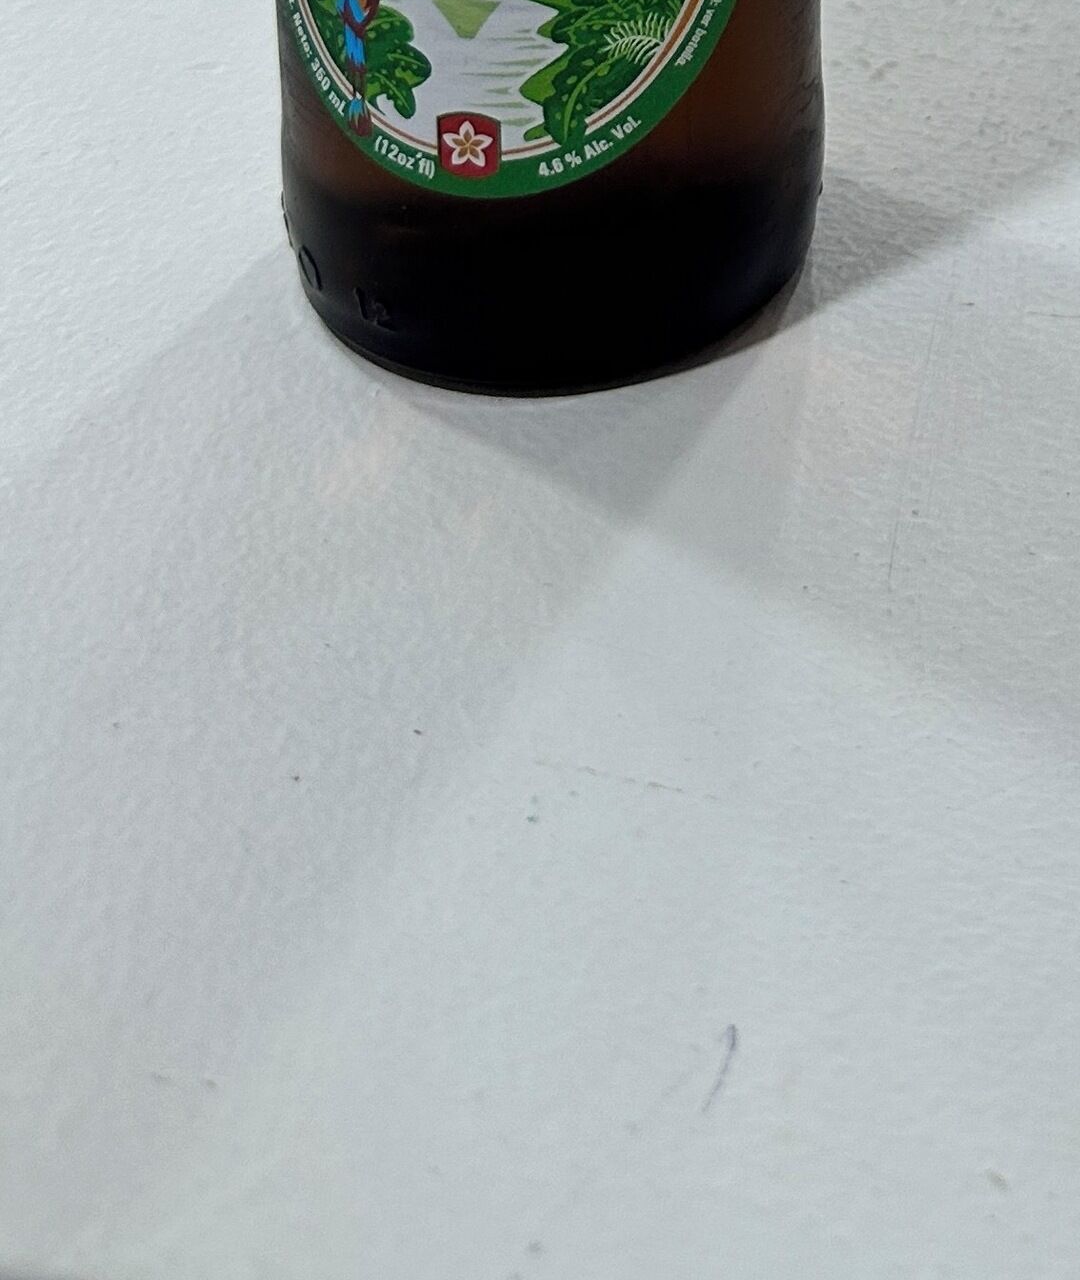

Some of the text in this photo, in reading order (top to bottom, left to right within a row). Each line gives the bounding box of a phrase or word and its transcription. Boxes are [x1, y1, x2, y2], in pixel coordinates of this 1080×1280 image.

[700, 9, 716, 28] ver
[292, 11, 312, 59] Neto:
[328, 90, 347, 117] mL
[583, 140, 615, 163] Alc.
[610, 117, 642, 140] Vol.
